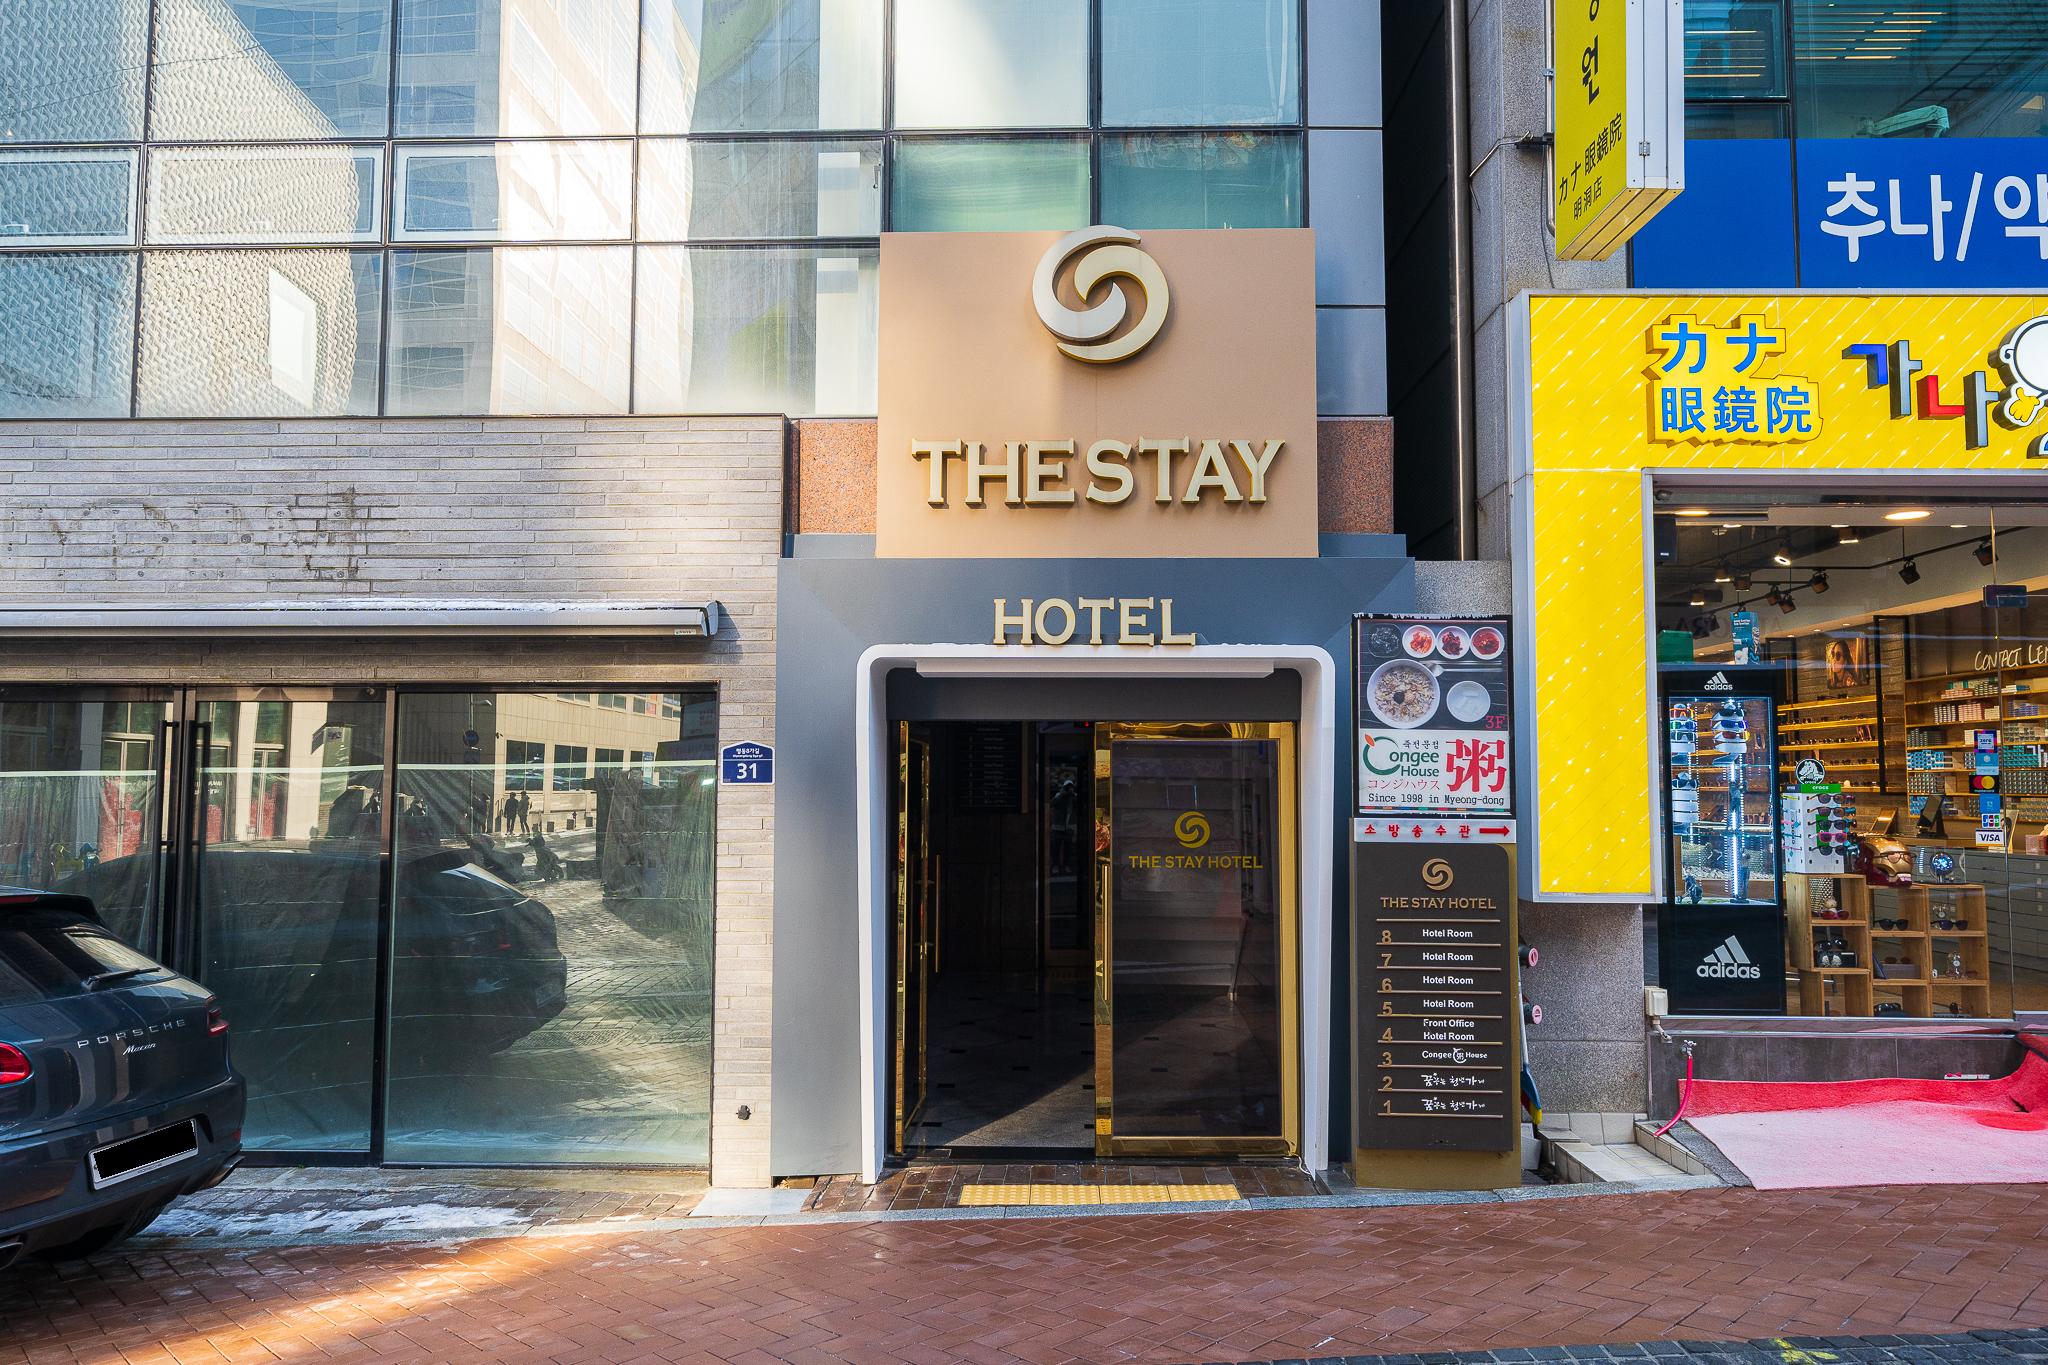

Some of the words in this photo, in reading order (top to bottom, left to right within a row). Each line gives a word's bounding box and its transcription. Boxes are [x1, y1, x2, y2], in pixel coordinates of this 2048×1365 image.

[1573, 175, 1602, 221] 明洞店
[1661, 323, 1777, 374] カナ
[1661, 386, 1812, 434] 眼鏡院
[911, 437, 1076, 506] THE
[1085, 436, 1286, 504] STAY
[993, 596, 1197, 647] HOTEL
[1974, 647, 2023, 671] CONTACT
[1703, 683, 1733, 691] adidas
[1485, 715, 1505, 730] 3F
[1402, 739, 1439, 749] 죽전문점
[1363, 736, 1440, 776] Congee
[736, 762, 757, 780] 31
[1400, 766, 1440, 777] House
[1446, 739, 1508, 793] 粥
[1368, 779, 1441, 791] コンジハウス
[1368, 793, 1396, 803] Since
[1401, 794, 1423, 803] 1998
[1429, 794, 1440, 804] in
[1444, 795, 1505, 806] Myeong-dong
[1980, 833, 2001, 842] VISA
[1128, 855, 1161, 869] THE
[1165, 855, 1205, 869] STAY
[1207, 855, 1263, 869] HOTEL
[1380, 897, 1409, 908] THE
[1411, 897, 1446, 909] STAY
[1448, 897, 1497, 909] HOTEL
[1381, 929, 1392, 944] 8
[1422, 928, 1446, 938] Hotel
[1447, 929, 1473, 938] Room
[1381, 953, 1392, 968] 7
[1422, 952, 1446, 961] Hotel
[1447, 952, 1474, 961] Room
[1696, 962, 1760, 979] adidas
[1381, 978, 1392, 993] 6
[1422, 975, 1446, 984] Hotel
[1447, 976, 1474, 985] Room
[1382, 1001, 1393, 1016] 5
[1423, 999, 1446, 1008] Hotel
[1448, 1000, 1474, 1008] Room
[1423, 1018, 1447, 1028] Front
[1448, 1018, 1475, 1028] Office
[76, 1018, 187, 1049] PORSCHE
[1381, 1027, 1393, 1043] 4
[1423, 1031, 1446, 1040] Hotel
[1448, 1031, 1475, 1041] Room
[122, 1042, 157, 1056] Macan
[1382, 1051, 1393, 1067] 3
[1421, 1050, 1452, 1060] Congee
[1465, 1051, 1488, 1059] House
[1382, 1076, 1393, 1091] 2
[1383, 1100, 1391, 1114] 1
